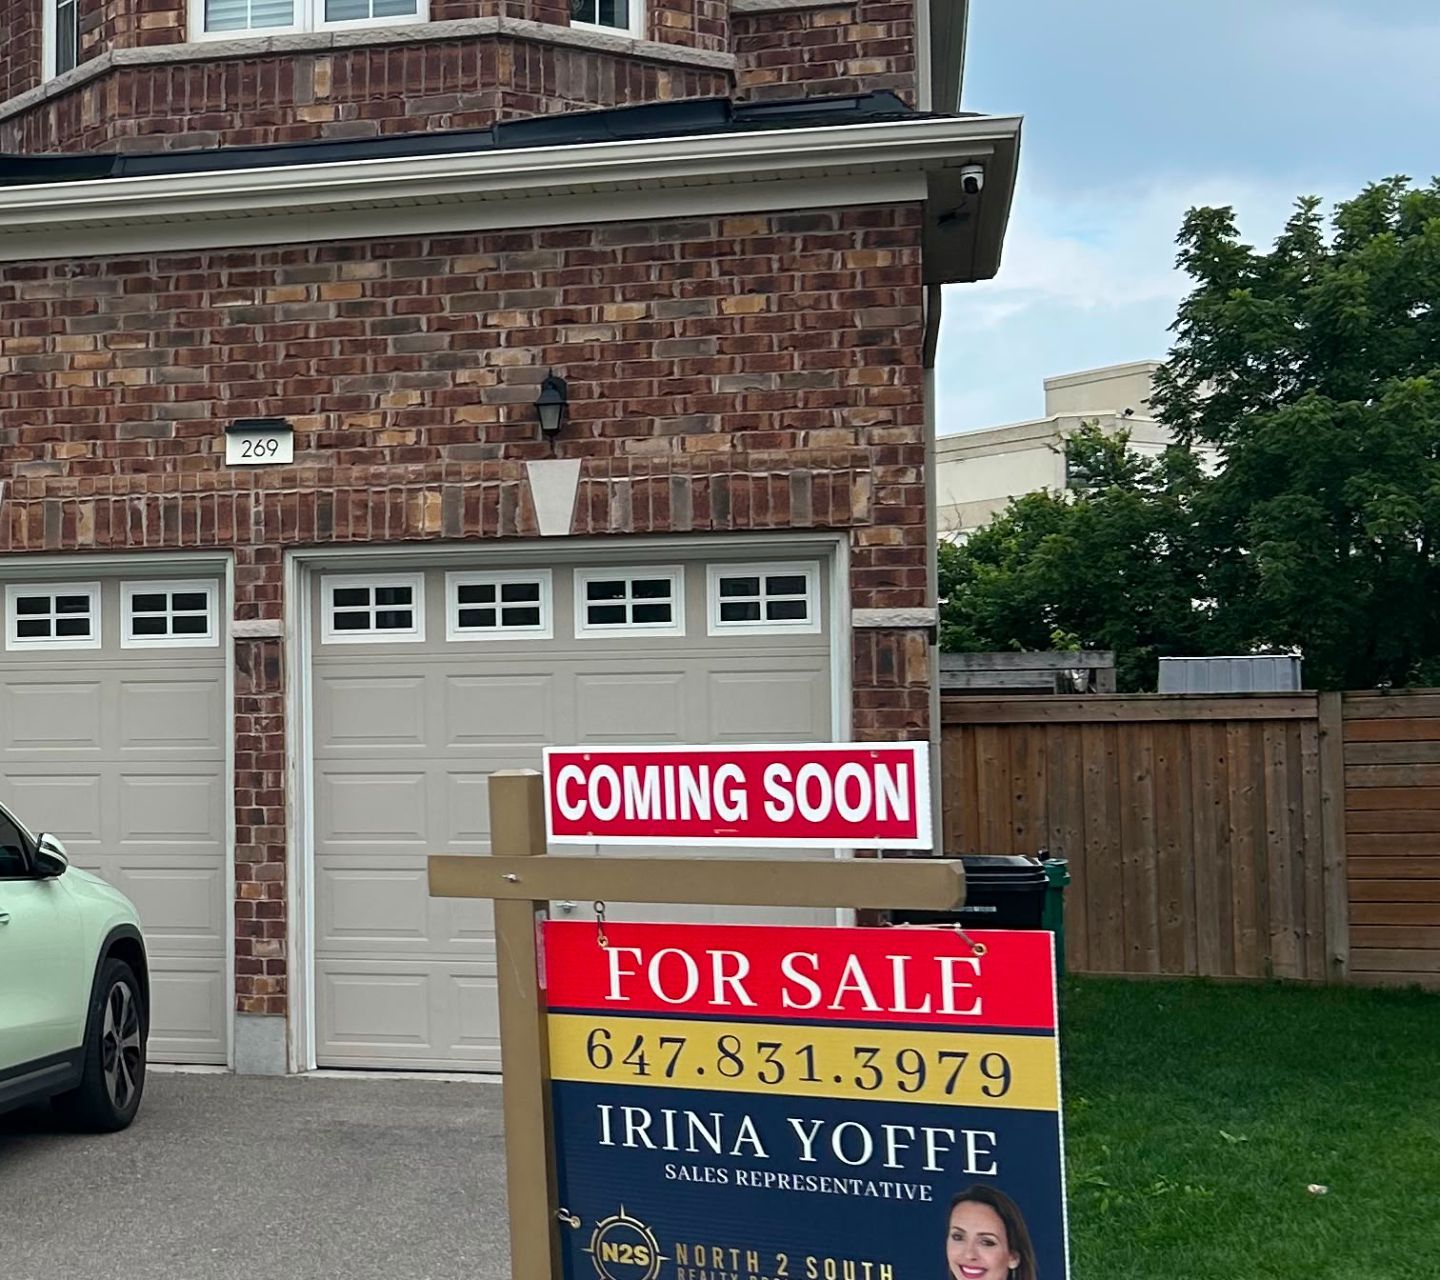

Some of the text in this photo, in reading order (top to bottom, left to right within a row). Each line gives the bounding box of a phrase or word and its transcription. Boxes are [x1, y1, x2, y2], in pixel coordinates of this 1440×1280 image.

[241, 438, 278, 458] 269
[556, 761, 910, 822] COMING SOON
[603, 946, 985, 1016] FOR SALE
[585, 1027, 1012, 1098] 647.831.3979
[597, 1104, 998, 1177] IRINA YOFFE
[665, 1163, 933, 1202] SALES REPRESENTATIVE
[601, 1240, 650, 1267] N2S
[675, 1242, 760, 1273] NORTH
[776, 1254, 789, 1277] 2
